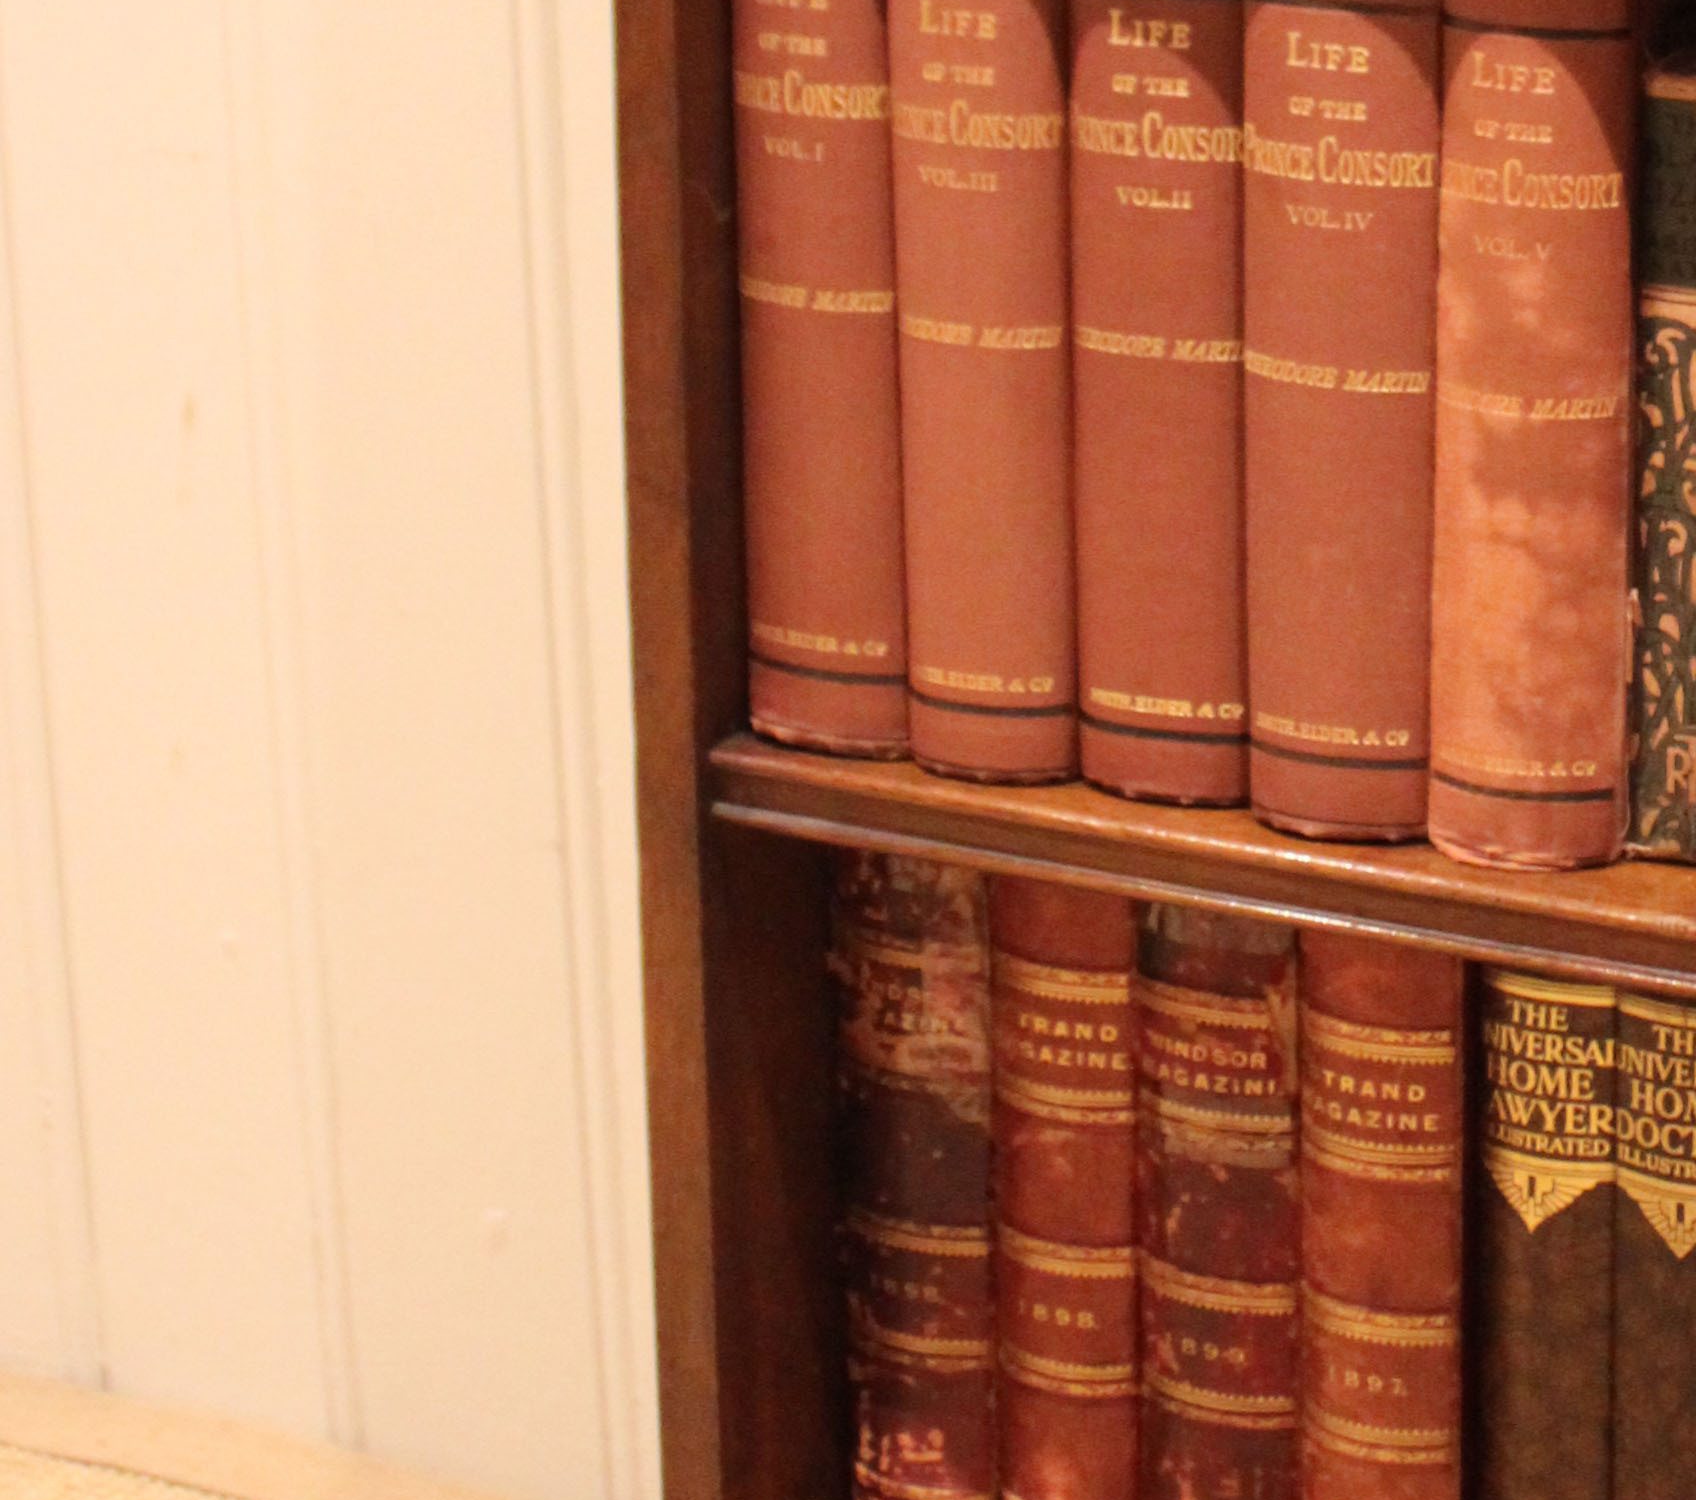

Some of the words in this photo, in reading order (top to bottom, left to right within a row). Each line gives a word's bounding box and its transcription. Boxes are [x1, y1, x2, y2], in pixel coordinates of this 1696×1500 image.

[787, 34, 827, 57] THE
[1108, 8, 1191, 49] LIFE
[1286, 32, 1370, 74] LIFE
[950, 65, 995, 86] THE
[1112, 74, 1138, 93] OF
[1144, 76, 1190, 98] THE
[1472, 51, 1556, 95] LIFE
[784, 69, 891, 120] CONSOR
[1289, 96, 1315, 116] OF
[1319, 100, 1367, 121] THE
[950, 100, 1062, 150] CONSORT
[1142, 111, 1244, 162] CONSOR
[1474, 119, 1500, 138] OF
[1505, 122, 1553, 143] THE
[1318, 136, 1435, 187] CONSORT
[1503, 159, 1622, 209] CONSORT
[1342, 370, 1431, 394] MARTIN
[1529, 397, 1617, 420] MARTIN
[1020, 1013, 1118, 1043] TRAND
[1506, 999, 1569, 1031] THE
[1484, 1019, 1616, 1068] NIVERSAL
[1323, 1069, 1426, 1103] TRAND
[1487, 1052, 1594, 1101] HOME
[1313, 1096, 1441, 1132] AGAZINE
[1491, 1089, 1616, 1135] AWYER
